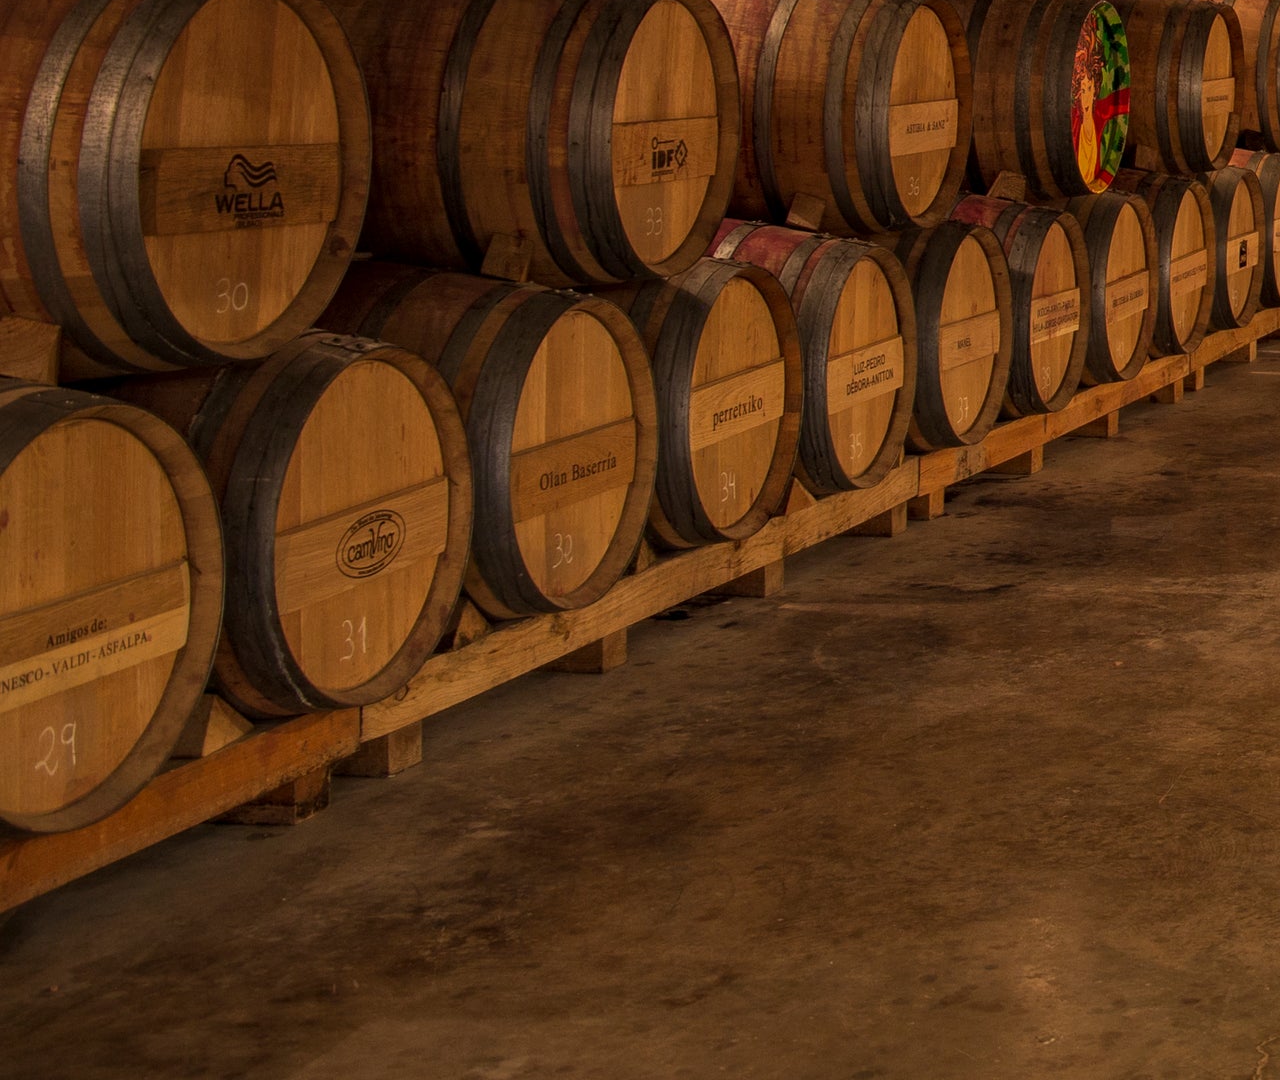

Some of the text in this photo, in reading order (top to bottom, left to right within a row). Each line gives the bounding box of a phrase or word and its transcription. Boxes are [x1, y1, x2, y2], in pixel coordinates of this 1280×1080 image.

[214, 191, 285, 214] WELLA
[646, 207, 663, 236] 33
[216, 278, 248, 313] 30
[854, 353, 886, 376] LUZ-PEDRO
[713, 395, 763, 431] perretxiko
[957, 397, 969, 424] 37
[849, 432, 863, 460] 35
[572, 451, 617, 481] Baserría
[721, 471, 736, 502] 34
[46, 618, 108, 649] Amigos de:
[339, 616, 367, 662] 31
[51, 650, 91, 675] VALDI
[98, 631, 149, 660] ASFALPA
[34, 719, 77, 777] 29
